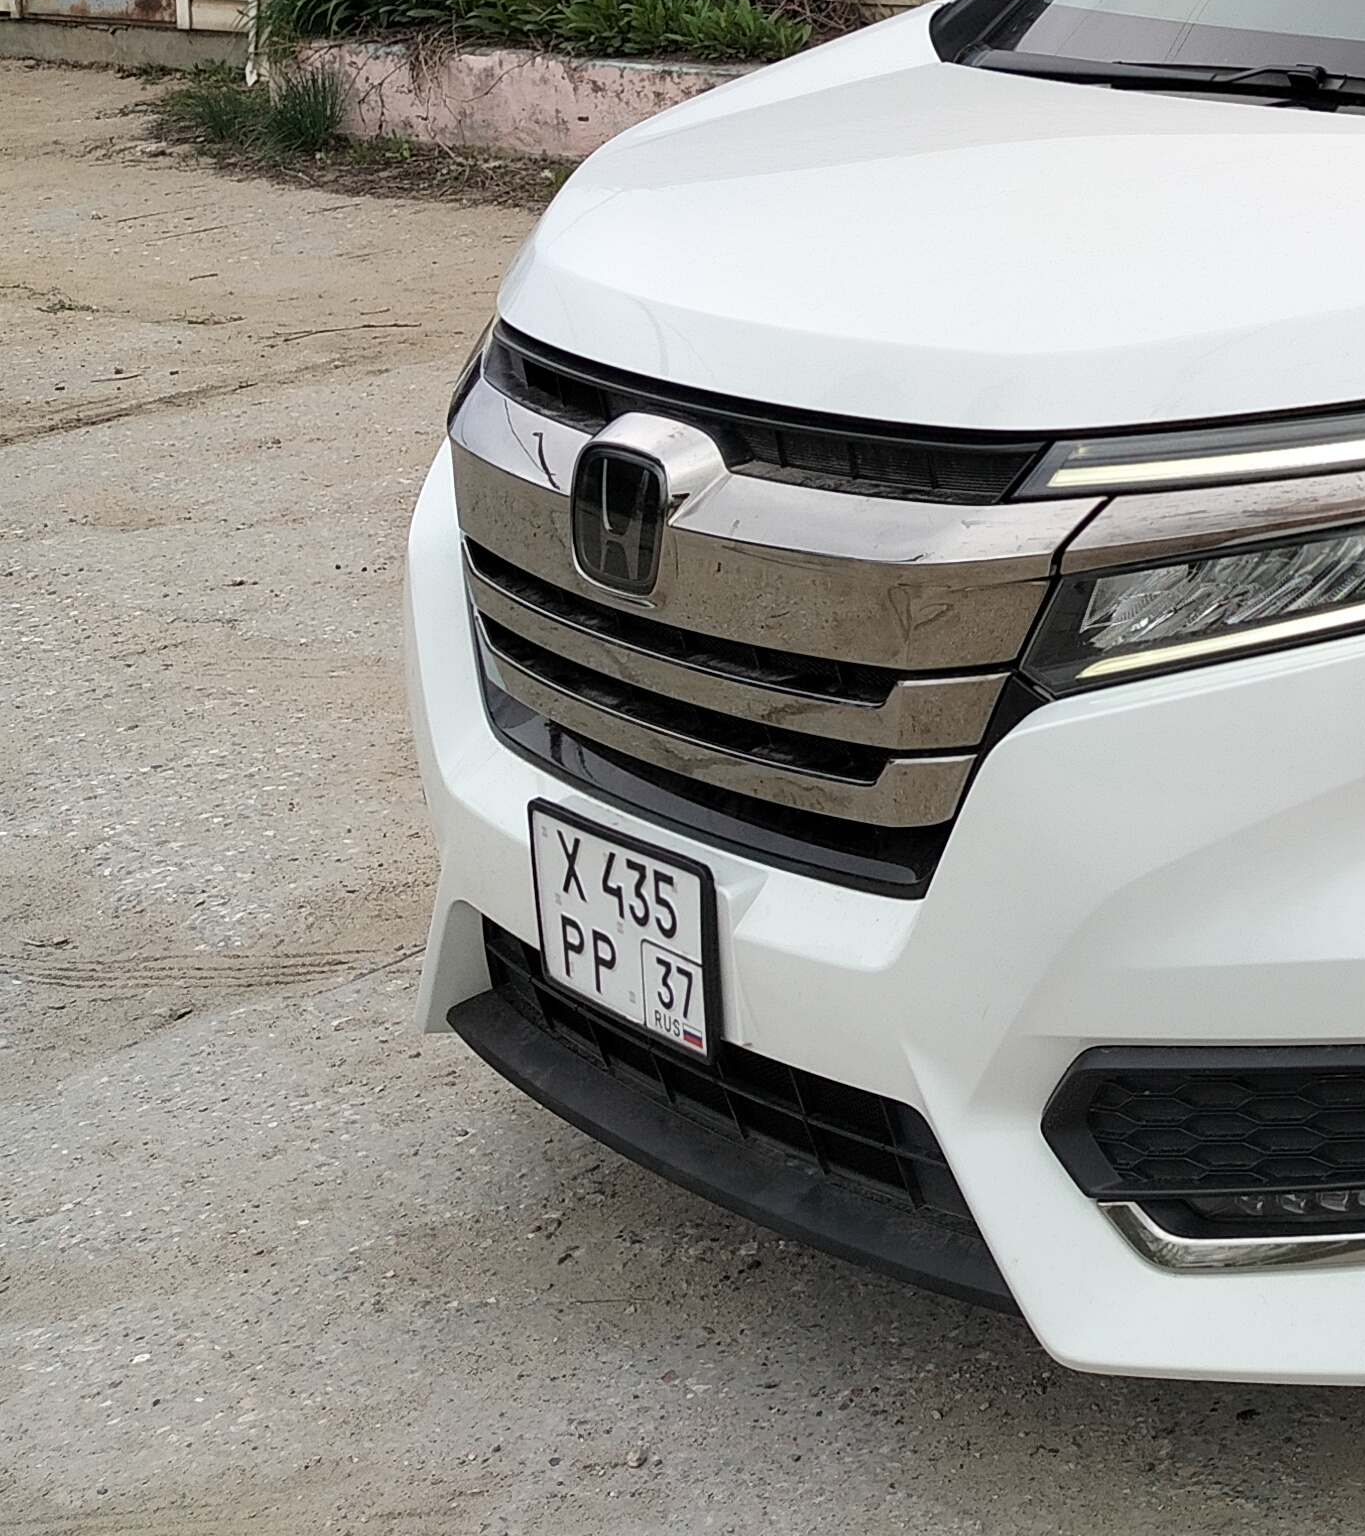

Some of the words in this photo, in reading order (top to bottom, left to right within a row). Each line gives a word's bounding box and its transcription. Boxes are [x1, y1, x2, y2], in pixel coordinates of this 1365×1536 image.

[601, 851, 679, 939] 435
[655, 955, 694, 1020] 37
[653, 1009, 681, 1038] RUS
